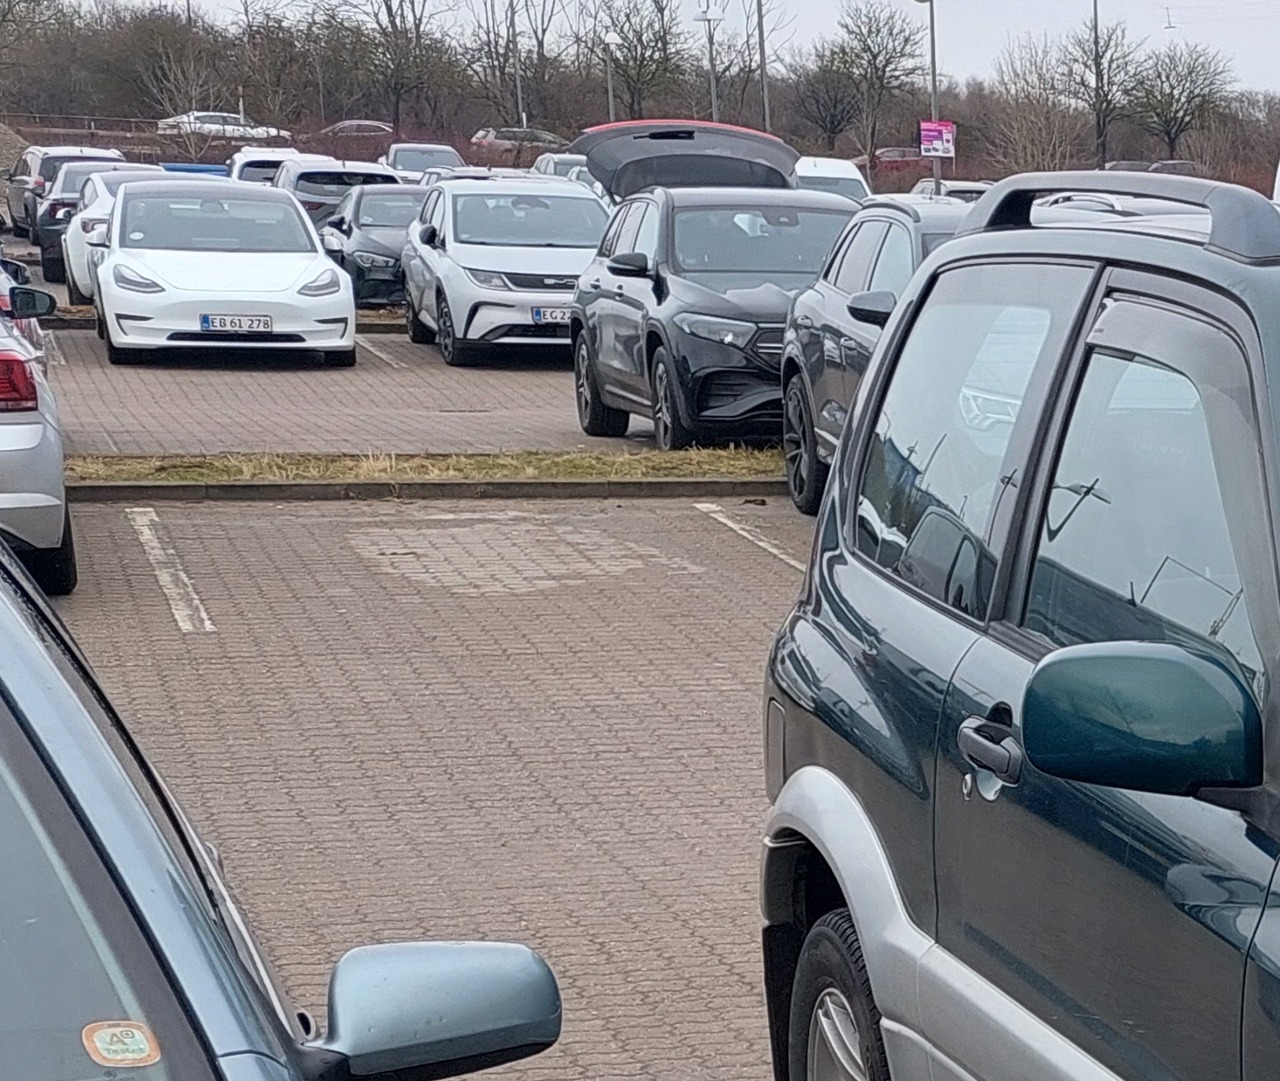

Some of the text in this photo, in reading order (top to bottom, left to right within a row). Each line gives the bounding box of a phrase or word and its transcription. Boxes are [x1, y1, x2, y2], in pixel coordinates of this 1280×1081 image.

[542, 310, 558, 320] EG
[211, 317, 270, 329] EB 61 278
